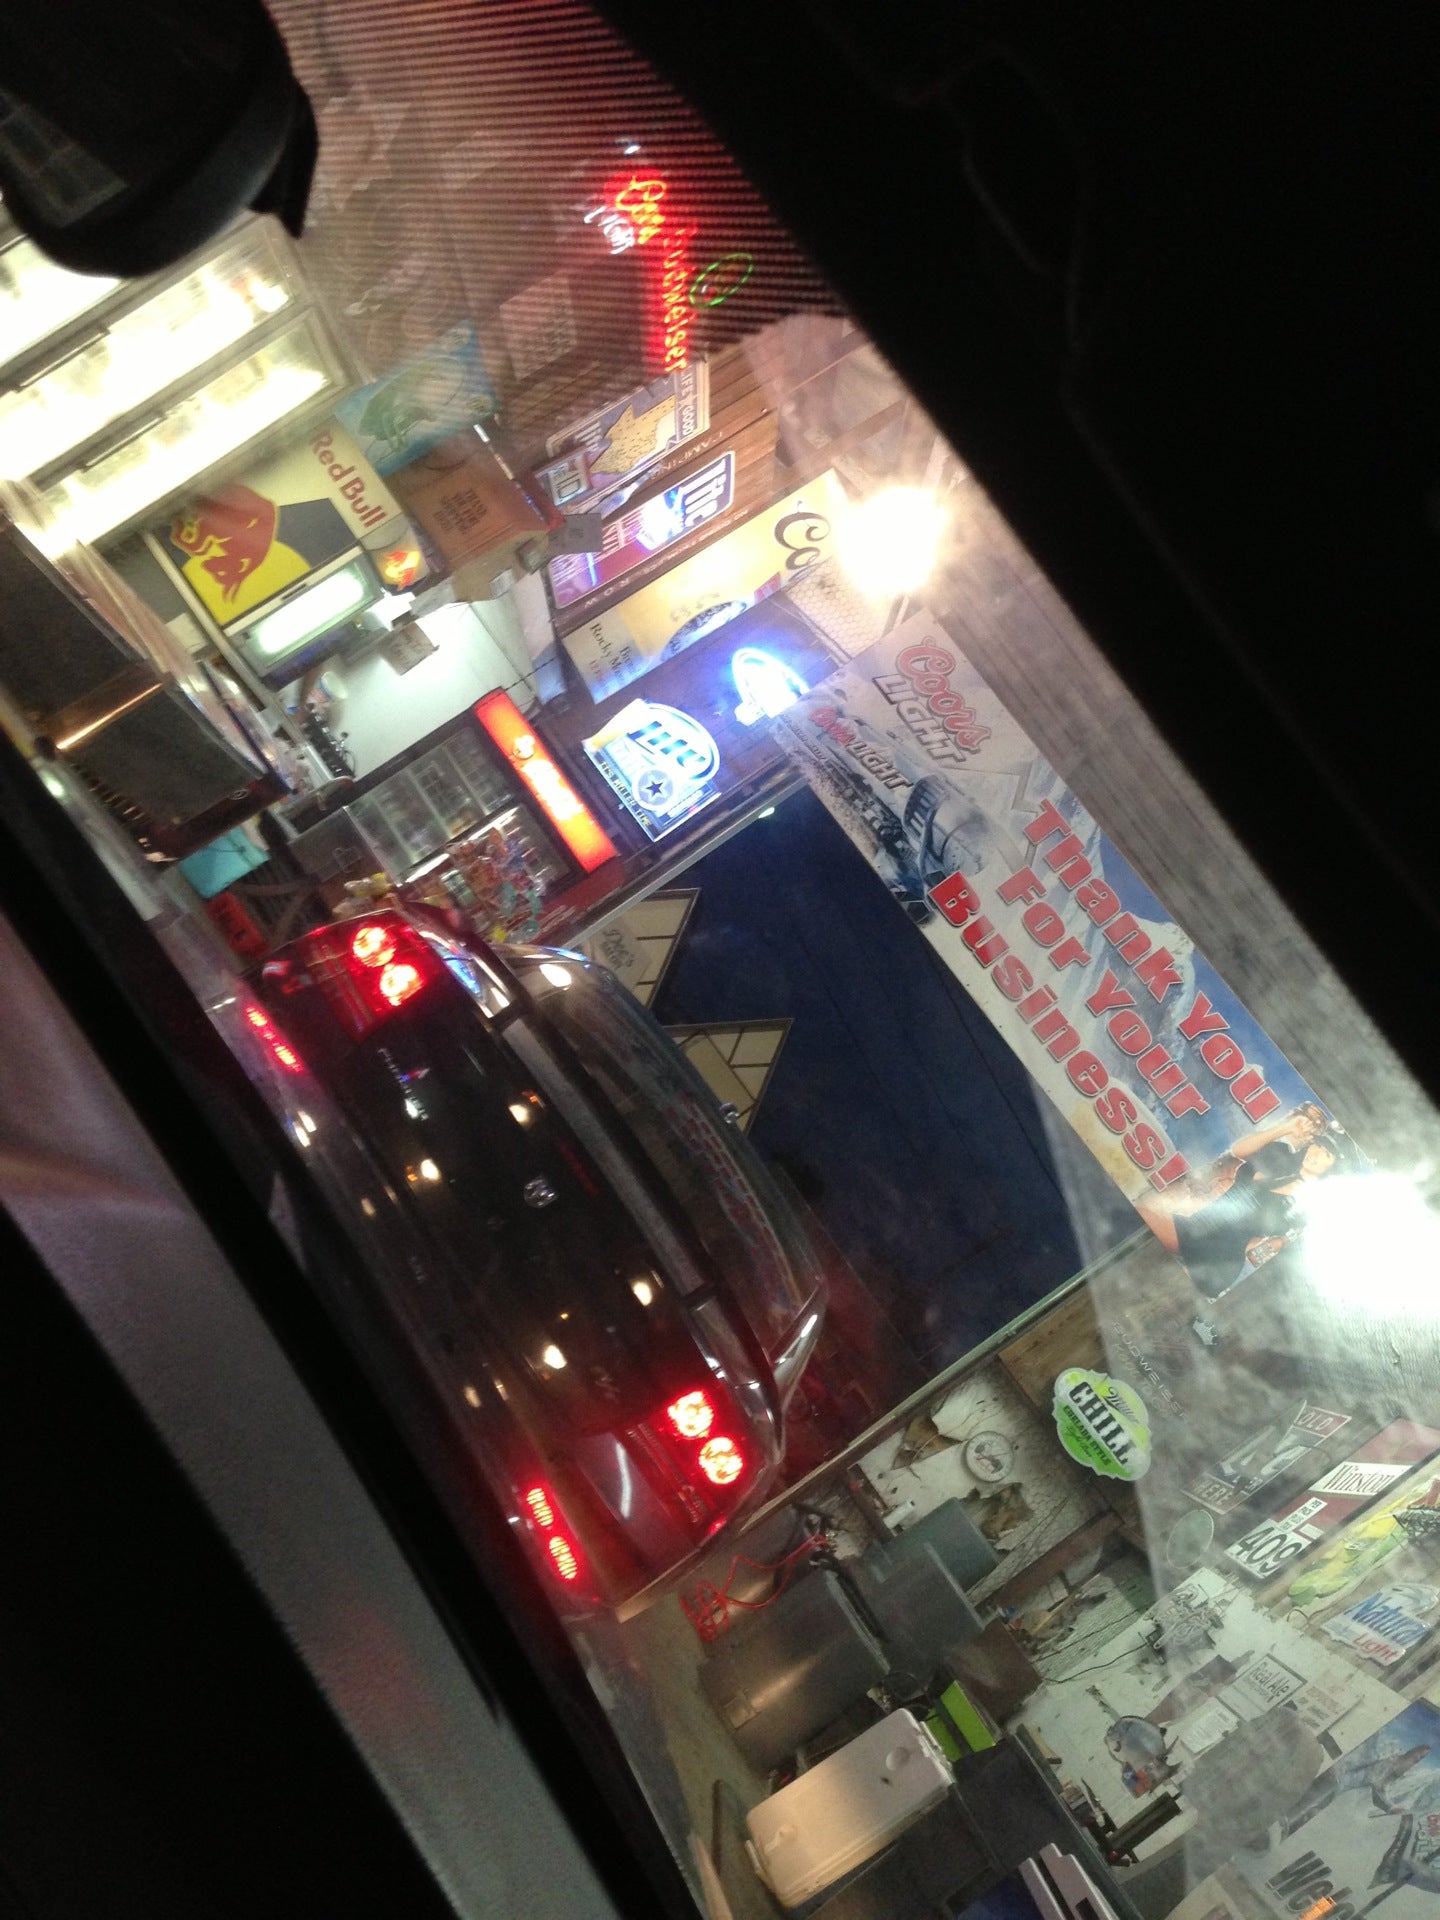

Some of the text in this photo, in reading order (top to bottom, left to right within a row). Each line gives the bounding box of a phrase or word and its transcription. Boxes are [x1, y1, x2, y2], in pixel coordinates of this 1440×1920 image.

[680, 402, 698, 436] GOOD
[312, 430, 386, 528] Red Bull
[587, 620, 616, 658] Rocky
[871, 668, 967, 767] LIGHT
[892, 635, 993, 755] Coors
[841, 739, 913, 790] LIGHT
[1017, 796, 1282, 1124] Thank You
[994, 865, 1211, 1122] For Your
[926, 869, 1192, 1193] Business!
[1067, 1379, 1138, 1467] CHILL
[1102, 1385, 1141, 1428] Miller
[1322, 1464, 1395, 1495] Winston
[1236, 1526, 1302, 1573] 409
[1342, 1590, 1429, 1647] Natural
[1351, 1630, 1399, 1662] Light
[1249, 1661, 1281, 1686] Real
[1265, 1676, 1293, 1698] Ale
